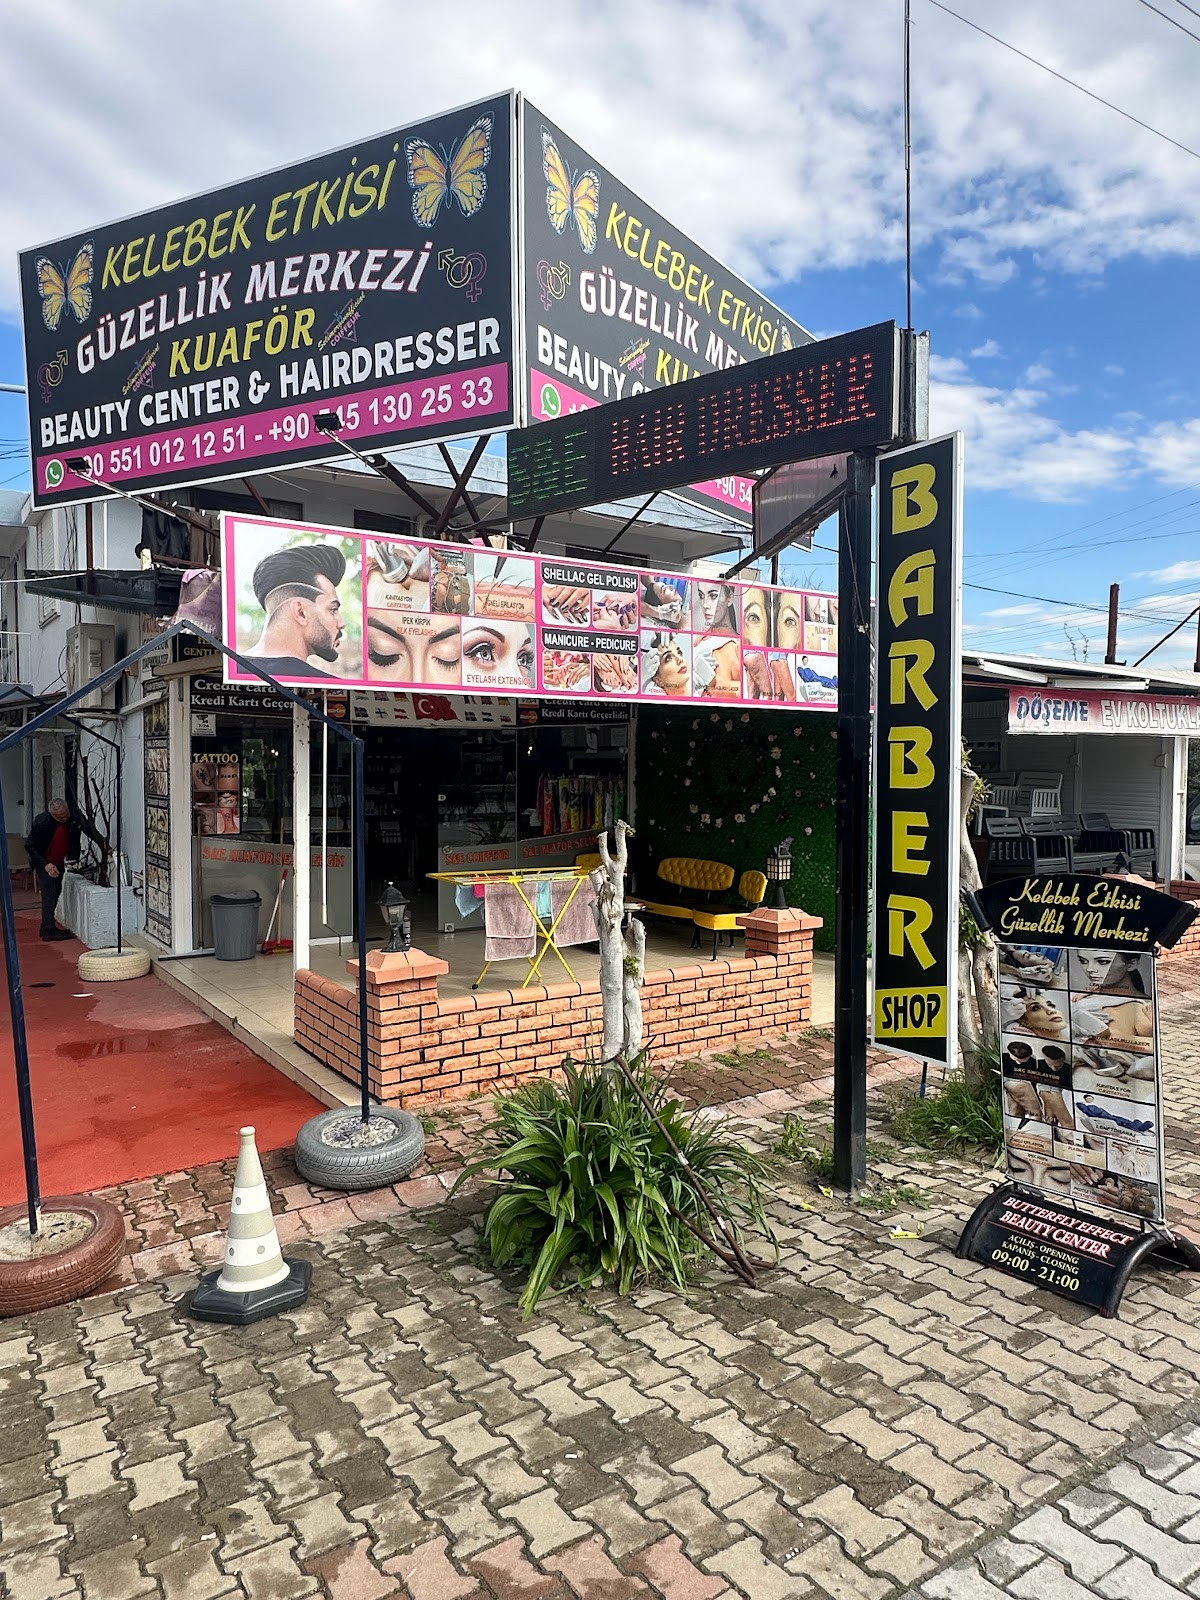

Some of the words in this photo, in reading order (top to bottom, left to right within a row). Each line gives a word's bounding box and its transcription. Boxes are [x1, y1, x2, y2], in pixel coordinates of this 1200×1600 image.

[101, 204, 257, 290] KELEBEK
[265, 142, 400, 243] ETKİSİ
[605, 201, 714, 315] KELEBEK
[717, 288, 781, 357] ETKİSİ
[76, 269, 232, 376] GÜZELLİK
[243, 241, 434, 306] MERKEZİ
[578, 265, 699, 354] GÜZELLİK
[169, 305, 316, 378] KUAFÖR
[537, 324, 626, 400] BEAUTY
[40, 398, 131, 449] BEAUTY
[138, 372, 241, 428] CENTER
[247, 370, 271, 405] &
[279, 317, 501, 399] HAIRDRESSER
[110, 445, 142, 474] 551
[149, 436, 185, 467] 012
[192, 431, 216, 459] 12
[222, 425, 247, 455] 51
[268, 412, 310, 443] +90
[368, 391, 413, 426] 130
[420, 383, 452, 417] 25
[461, 376, 494, 410] 33
[543, 567, 586, 585] SHELLAC
[586, 573, 605, 587] GEL
[606, 575, 637, 590] POLISH
[544, 631, 590, 648] MANICURE
[595, 636, 637, 652] PEDICURE
[190, 694, 225, 706] Kredi
[228, 696, 259, 707] Kartı
[466, 674, 497, 684] EYELASH
[497, 675, 532, 686] EXTENSION
[542, 708, 565, 719] Kredi
[567, 709, 588, 719] Kartı
[590, 710, 629, 721] Geçerlidir
[887, 462, 939, 971] BARBER
[1016, 692, 1089, 727] DÖŞEME
[1101, 700, 1122, 727] EV
[193, 753, 239, 764] TATTOO
[523, 846, 540, 858] S&E
[1009, 878, 1080, 906] Kelebek
[1087, 881, 1142, 911] Etkisi
[1000, 905, 1064, 936] Güzellik
[1073, 910, 1149, 942] Merkezi
[881, 993, 942, 1034] SHOP
[999, 1210, 1054, 1240] BEAUTY
[1052, 1228, 1111, 1260] CENTER
[1002, 1196, 1081, 1229] BUTTERFLY
[1079, 1219, 1135, 1247] EFFECT
[991, 1248, 1030, 1272] 09:00
[1038, 1265, 1080, 1292] 21:00
[1001, 1241, 1036, 1259] KAPANIŞ
[1040, 1255, 1079, 1275] CLOSING
[1008, 1234, 1035, 1249] AÇILIŞ
[1039, 1245, 1079, 1265] OPENING
